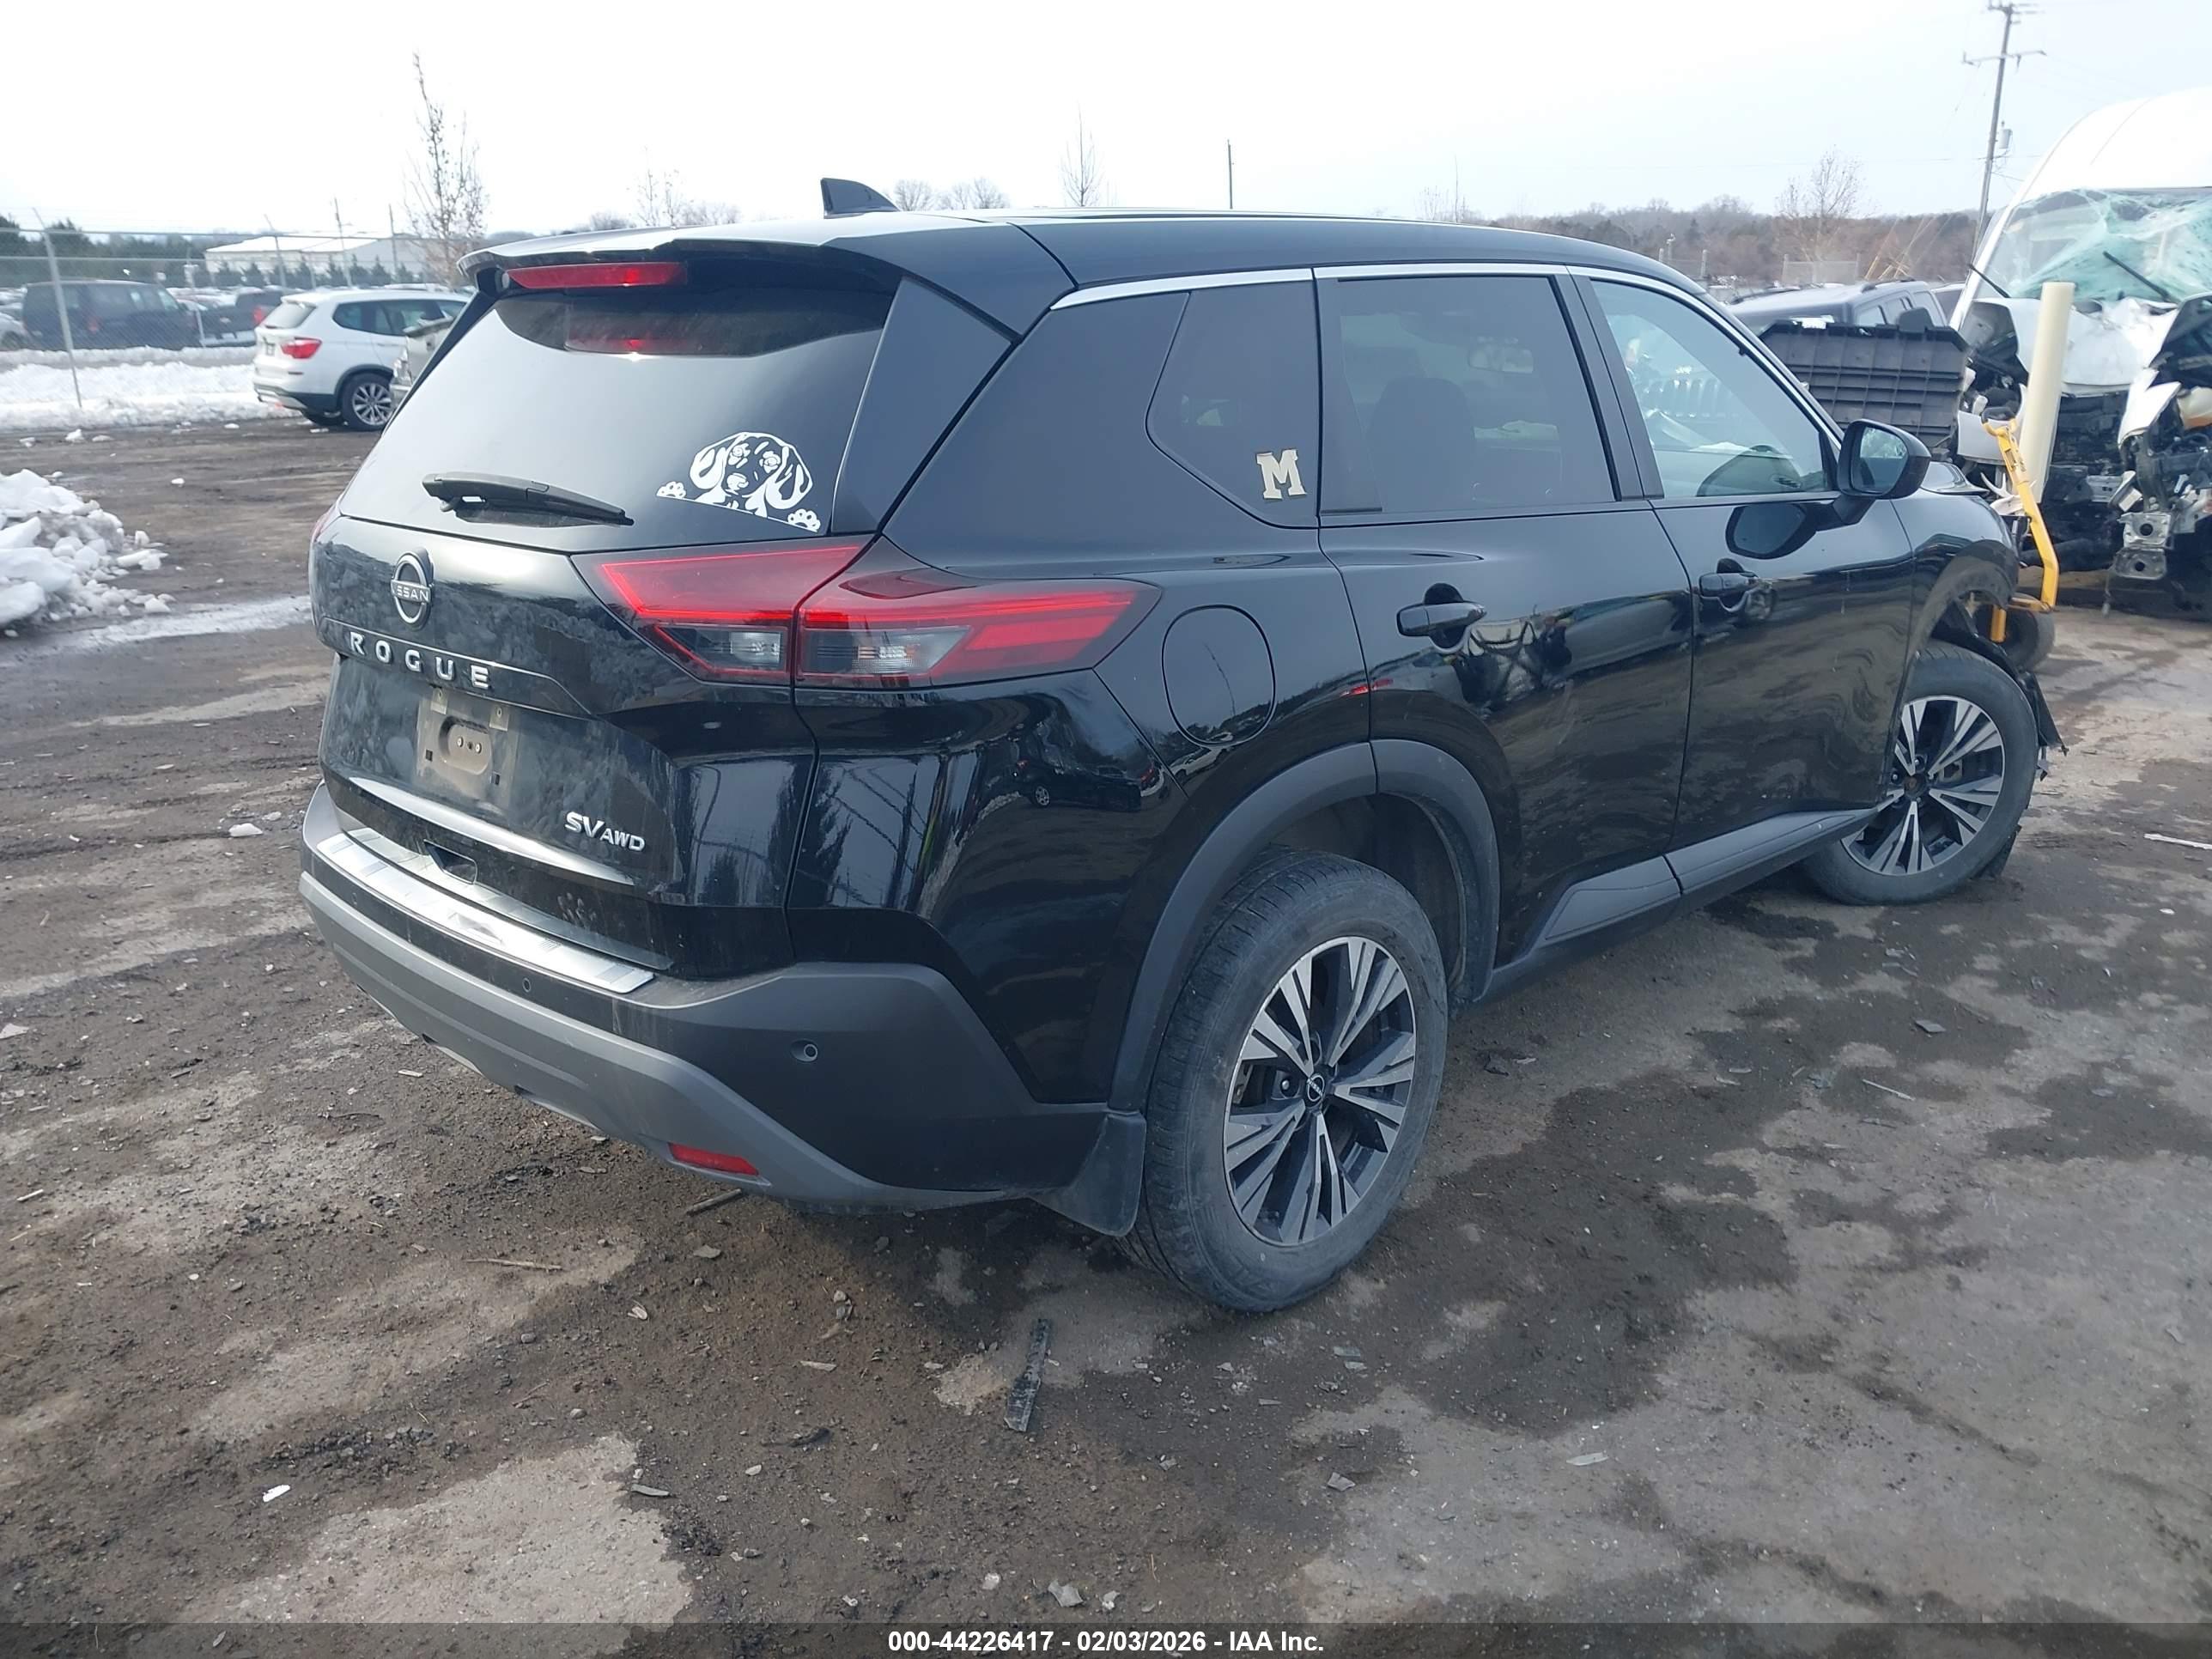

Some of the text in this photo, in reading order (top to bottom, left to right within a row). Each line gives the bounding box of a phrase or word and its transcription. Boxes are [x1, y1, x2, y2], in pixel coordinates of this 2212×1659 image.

[1256, 449, 1306, 499] M
[392, 583, 429, 602] SSAN
[349, 631, 489, 690] ROGUE
[565, 811, 646, 851] SV AWD
